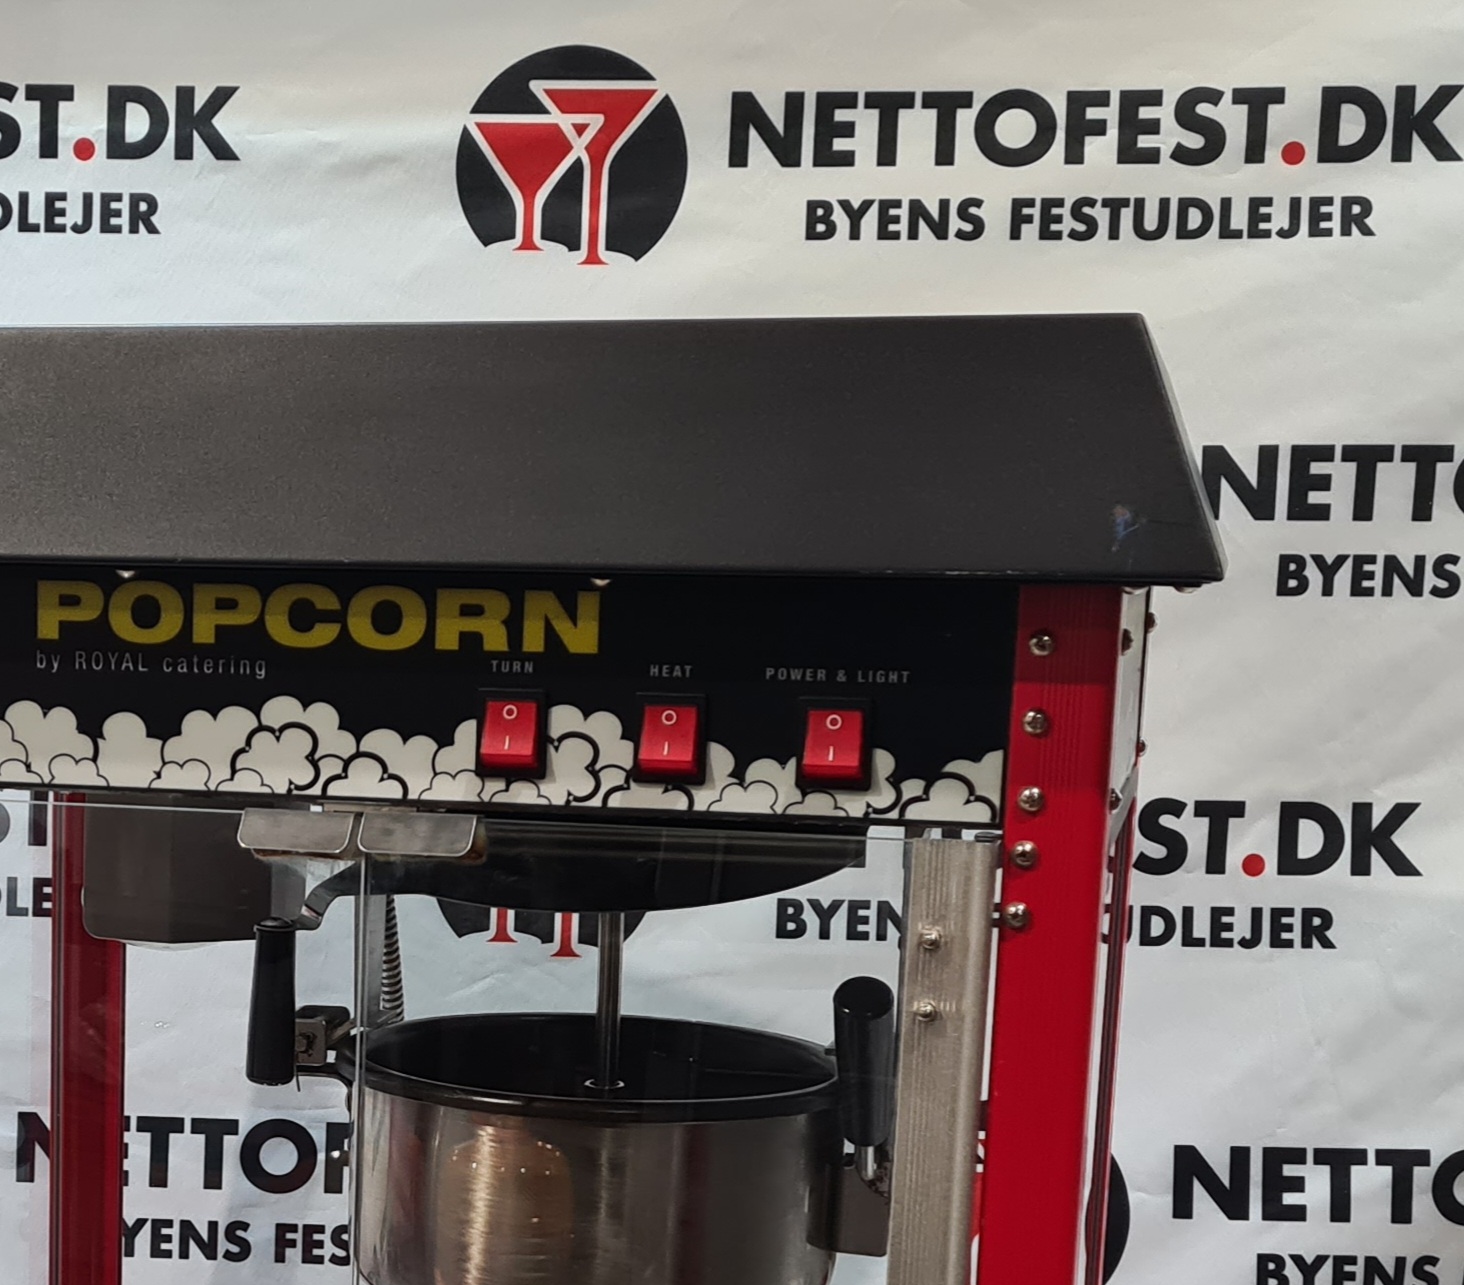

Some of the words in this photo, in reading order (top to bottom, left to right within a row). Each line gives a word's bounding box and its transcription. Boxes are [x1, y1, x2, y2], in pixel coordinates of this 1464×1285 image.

[727, 84, 1464, 168] NETTOFEST.DK
[804, 198, 985, 242] BYENS
[1009, 195, 1376, 240] FESTUDLEJER
[1201, 443, 1464, 523] NETT
[1276, 553, 1462, 598] BYENS
[36, 579, 601, 654] POPCORN
[36, 650, 61, 673] by
[74, 650, 149, 672] ROYAL
[163, 653, 267, 679] catering
[491, 660, 534, 674] TURN
[649, 664, 693, 679] HEAT
[765, 667, 827, 682] POWER
[836, 669, 847, 682] &
[857, 670, 911, 684] LIGHT
